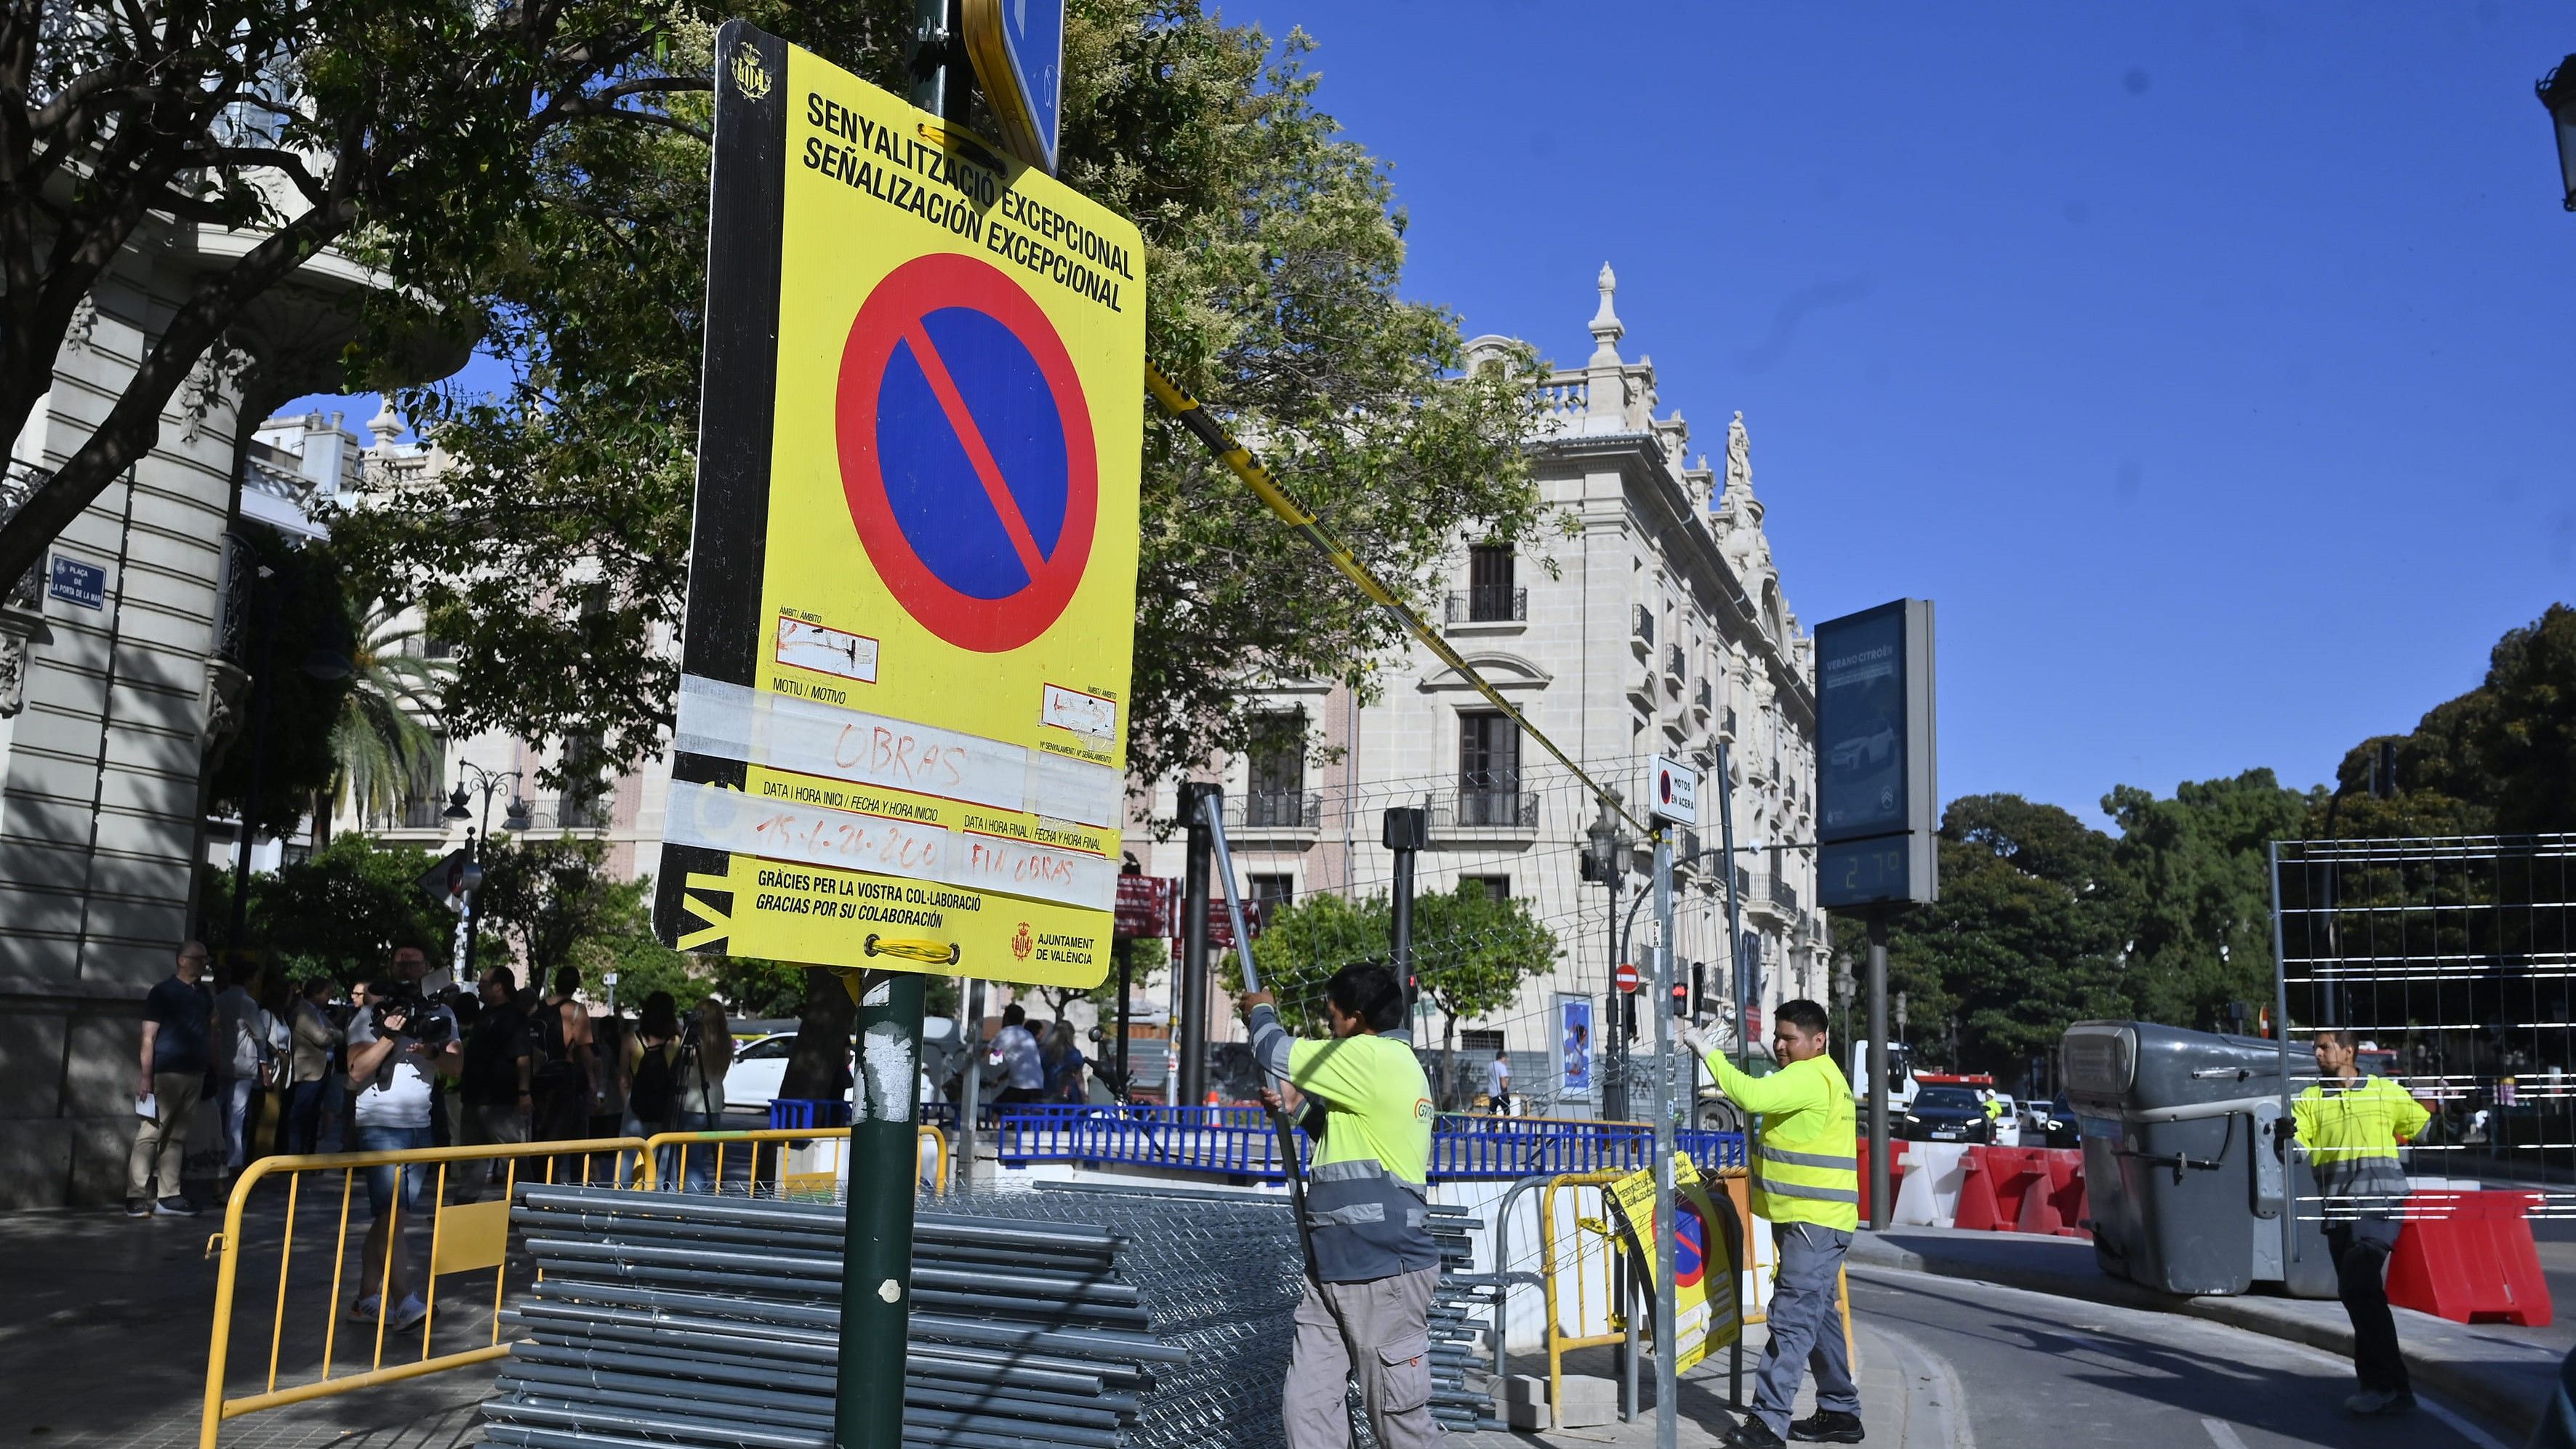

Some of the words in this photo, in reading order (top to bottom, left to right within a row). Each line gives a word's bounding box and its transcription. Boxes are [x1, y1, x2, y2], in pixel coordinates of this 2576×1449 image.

[807, 92, 995, 208] SENYALITZACIÓ
[1002, 186, 1133, 281] EXCEPCIONAL
[803, 137, 984, 244] SEÑALIZACIÓN
[986, 220, 1122, 313] EXCEPCIONAL
[69, 566, 88, 578] PLAÇA
[59, 583, 75, 596] PORTA
[76, 588, 82, 598] DE
[91, 593, 101, 603] MAR
[1826, 655, 1858, 671] VERANO
[1858, 644, 1893, 663] CITROËN
[773, 677, 803, 697] MOTIU
[811, 686, 846, 705] MOTIVO
[835, 723, 966, 788] OBRAS
[1674, 776, 1691, 792] MOTOS
[763, 781, 789, 798] DATA
[796, 787, 822, 804] HORA
[823, 791, 843, 807] INICI
[851, 796, 880, 813] FECHA
[882, 800, 889, 814] Y
[889, 802, 913, 817] HORA
[914, 806, 939, 822] INICIO
[1672, 793, 1677, 805] EN
[1679, 797, 1694, 810] ACERA
[964, 814, 984, 830] DATA
[989, 819, 1008, 834] HORA
[1010, 823, 1029, 838] FINAL
[1035, 827, 1056, 843] FECHA
[1058, 832, 1064, 843] Y
[1063, 833, 1083, 848] HORA
[1083, 837, 1102, 851] FINAL
[971, 843, 1007, 875] FIN
[1014, 854, 1075, 887] OBRAS
[758, 869, 811, 891] GRÀCIES
[814, 877, 836, 894] PER
[839, 880, 854, 896] LA
[858, 882, 903, 902] VOSTRA
[906, 887, 981, 912] COL·LABORACIÓ
[756, 893, 810, 915] GRACIAS
[811, 899, 838, 918] POR
[839, 903, 856, 919] SU
[858, 905, 944, 928] COLABORACIÓN
[1035, 949, 1048, 960] DE
[1051, 949, 1093, 965] VALÈNCIA
[1038, 934, 1095, 950] AJUNTAMENT
